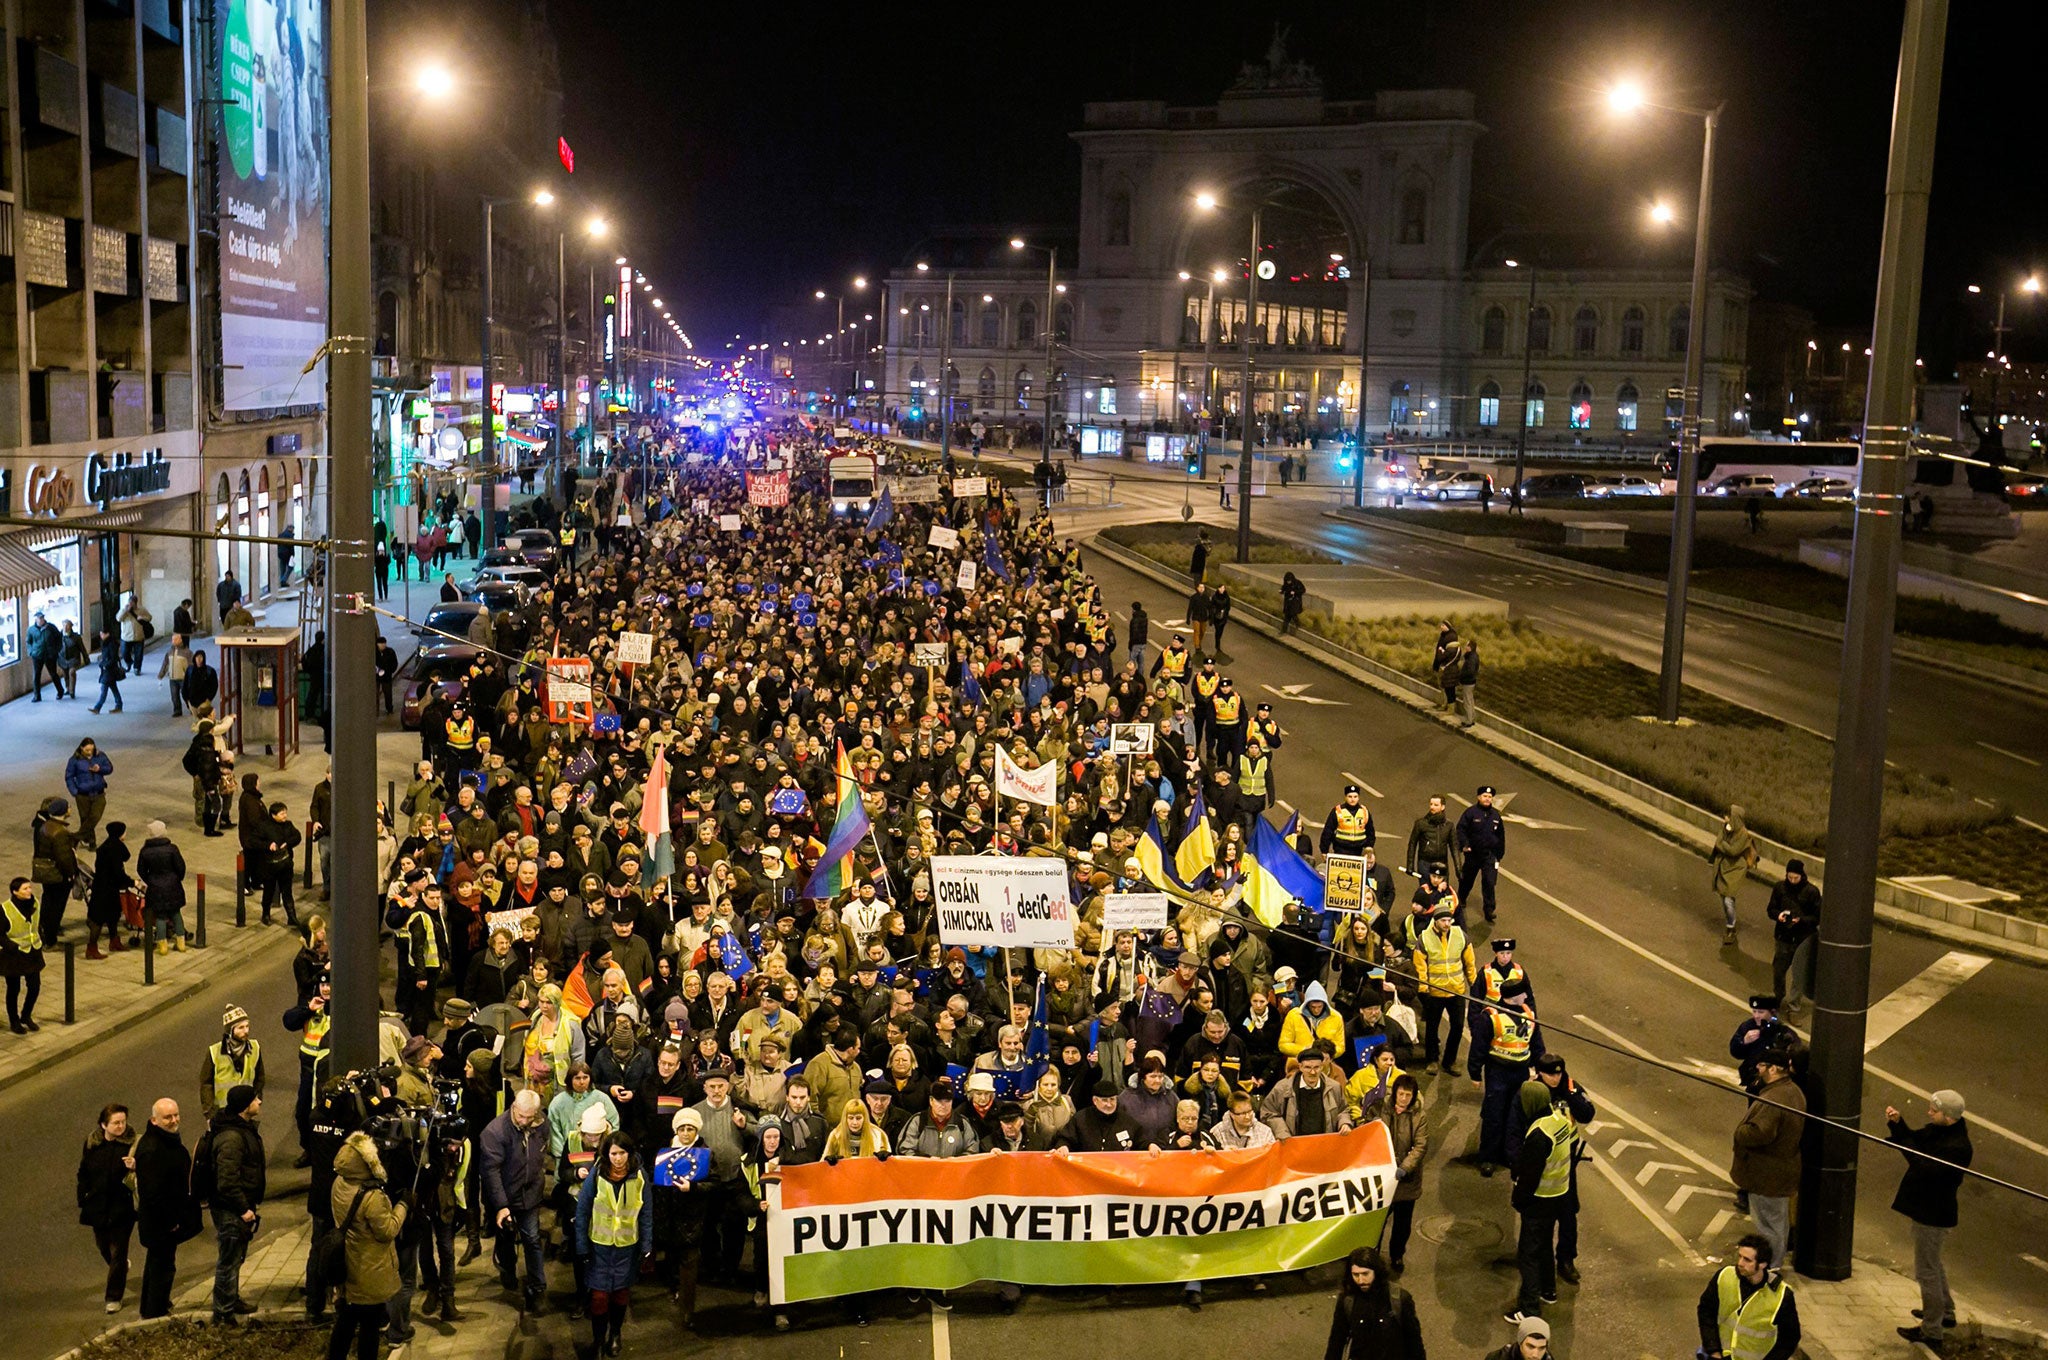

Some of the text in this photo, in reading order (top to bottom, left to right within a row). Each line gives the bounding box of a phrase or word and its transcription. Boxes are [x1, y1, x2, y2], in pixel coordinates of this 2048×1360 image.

[954, 867, 983, 875] cinizmus
[1330, 860, 1361, 870] ACHTUNG
[939, 877, 980, 904] ORBÁN
[1004, 886, 1011, 905] 1
[1017, 893, 1067, 921] deciGeci
[1329, 896, 1359, 908] RUSSIA!
[942, 910, 994, 932] SIMICSKA
[1000, 912, 1017, 933] fél
[793, 1174, 1384, 1254] PUTYIN NYET! EURÓPA IGEN!
